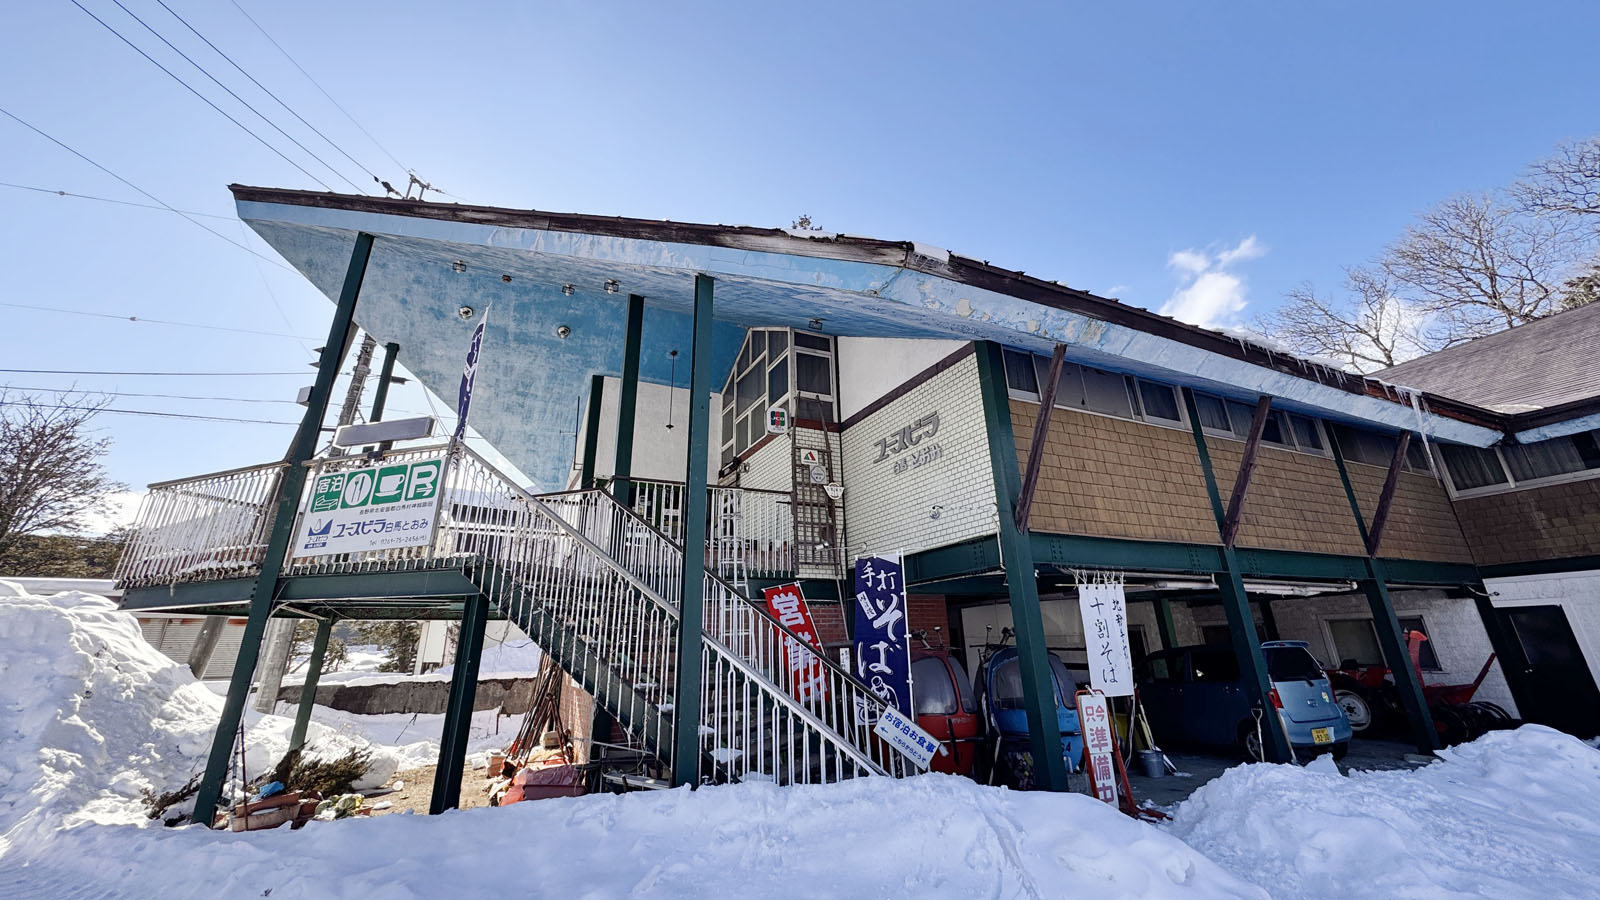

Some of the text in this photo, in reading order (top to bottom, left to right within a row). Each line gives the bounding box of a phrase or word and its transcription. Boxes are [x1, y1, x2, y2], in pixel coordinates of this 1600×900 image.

[317, 477, 343, 494] 宿泊
[860, 560, 897, 592] 手打
[858, 593, 904, 679] そば
[1090, 597, 1119, 684] 十割そば
[884, 712, 937, 754] お宿泊お食事
[1089, 725, 1115, 804] 準備中
